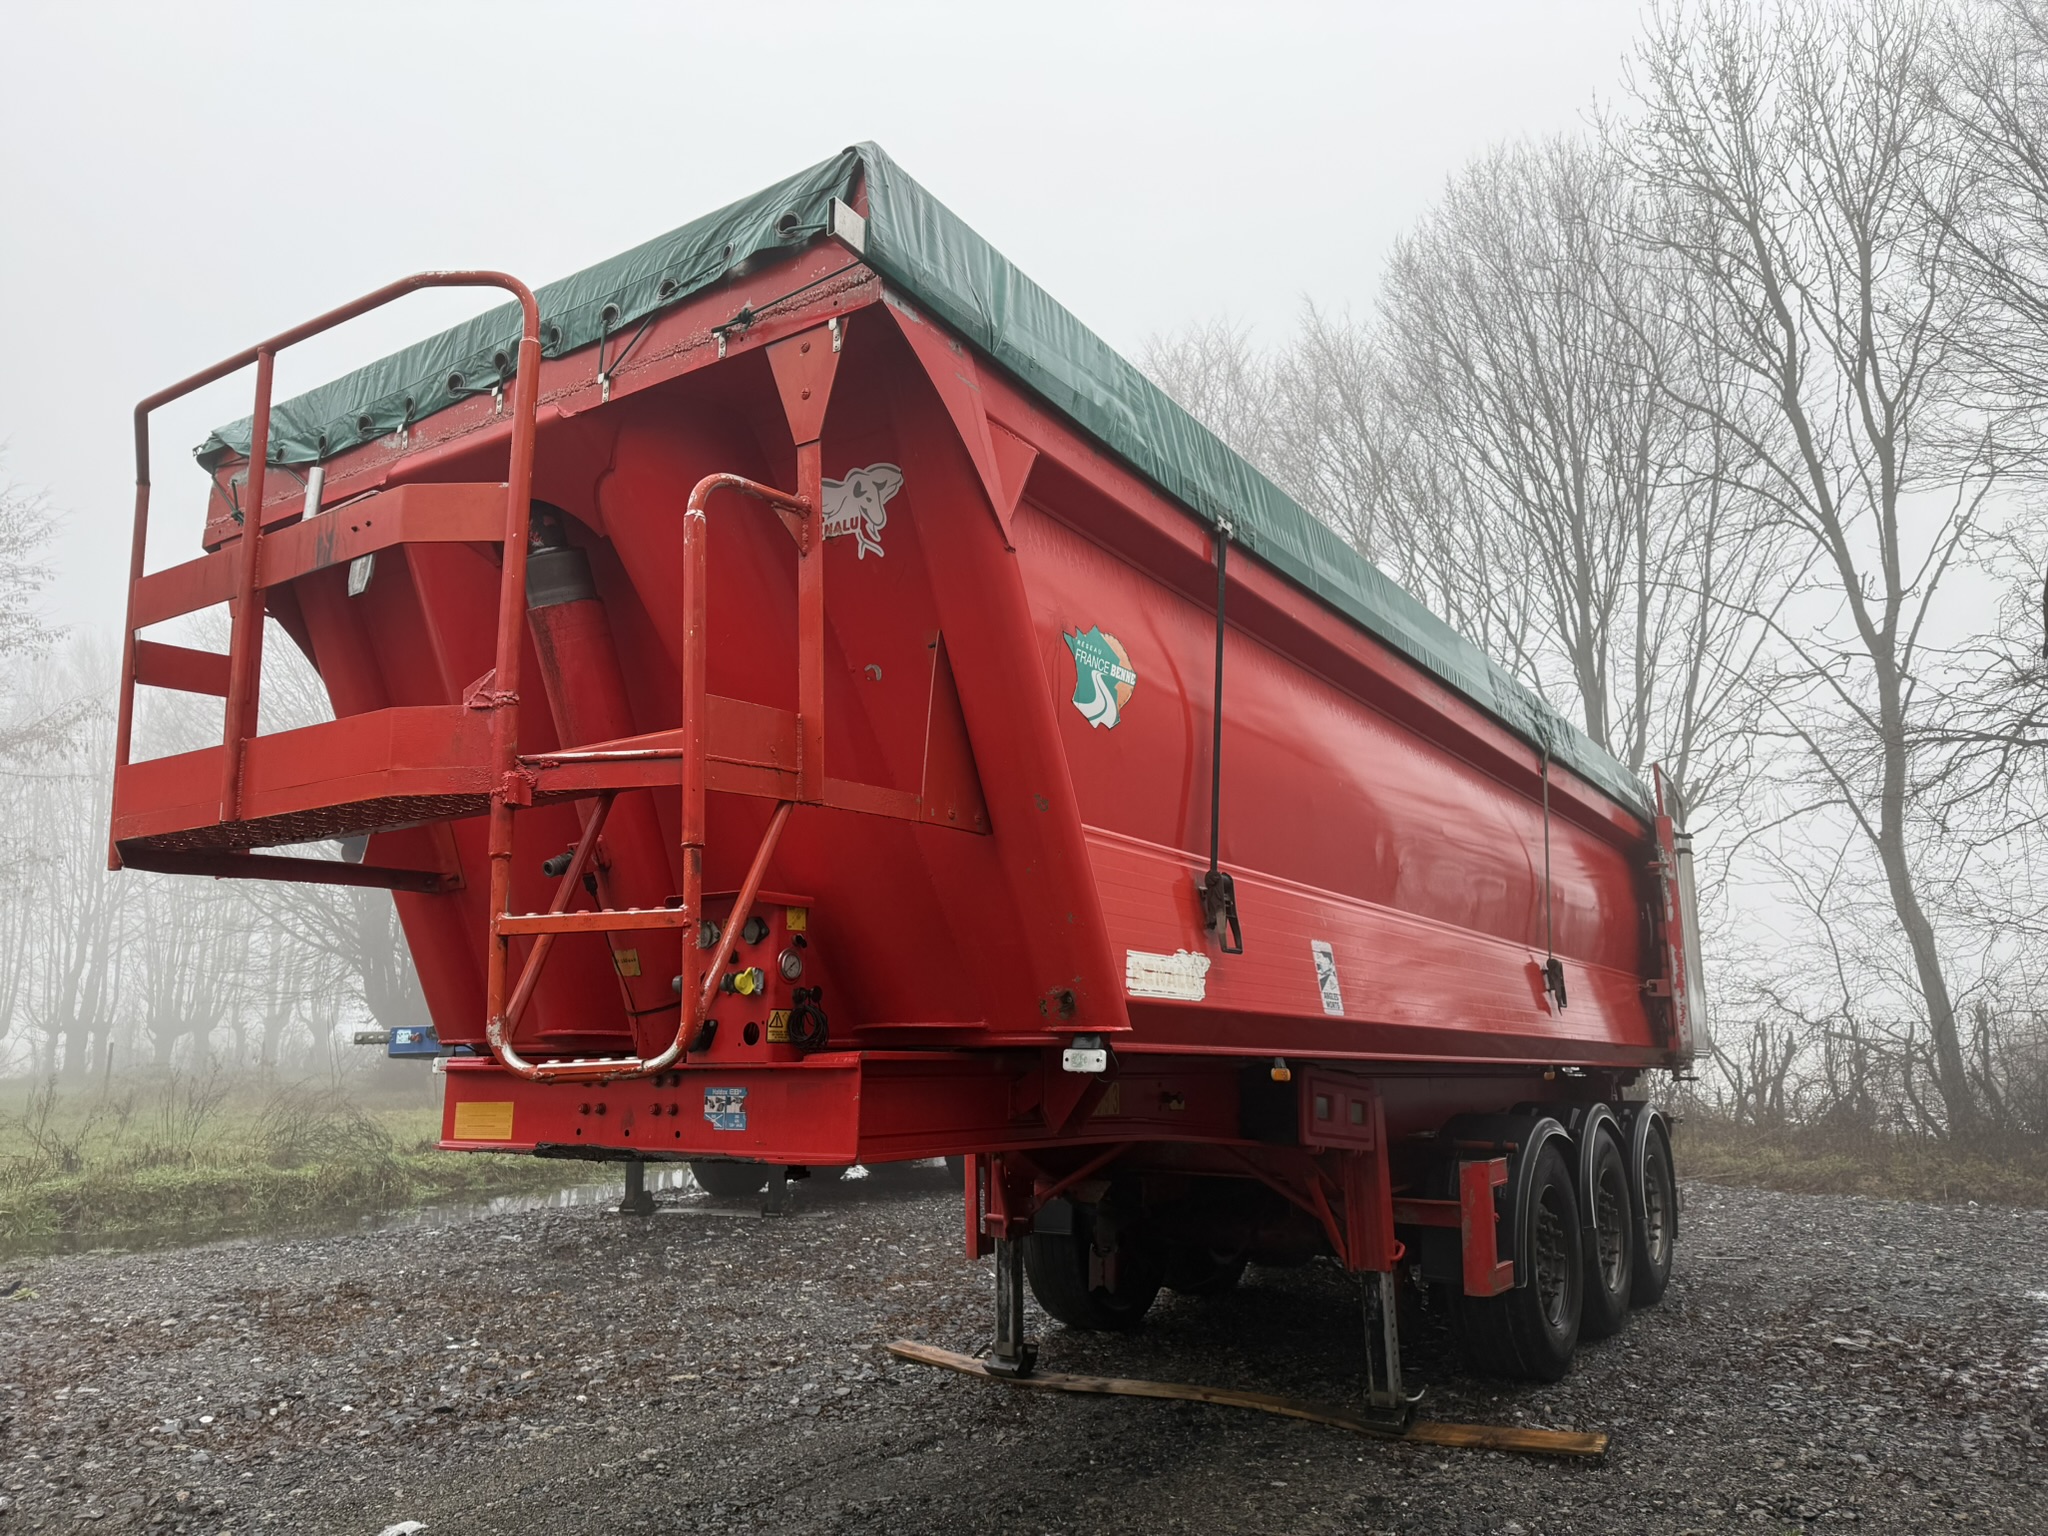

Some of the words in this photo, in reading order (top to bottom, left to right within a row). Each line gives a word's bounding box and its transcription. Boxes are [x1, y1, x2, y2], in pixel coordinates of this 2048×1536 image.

[822, 516, 859, 535] NALU
[1075, 648, 1110, 674] FRANCE
[1110, 664, 1137, 685] BENNE
